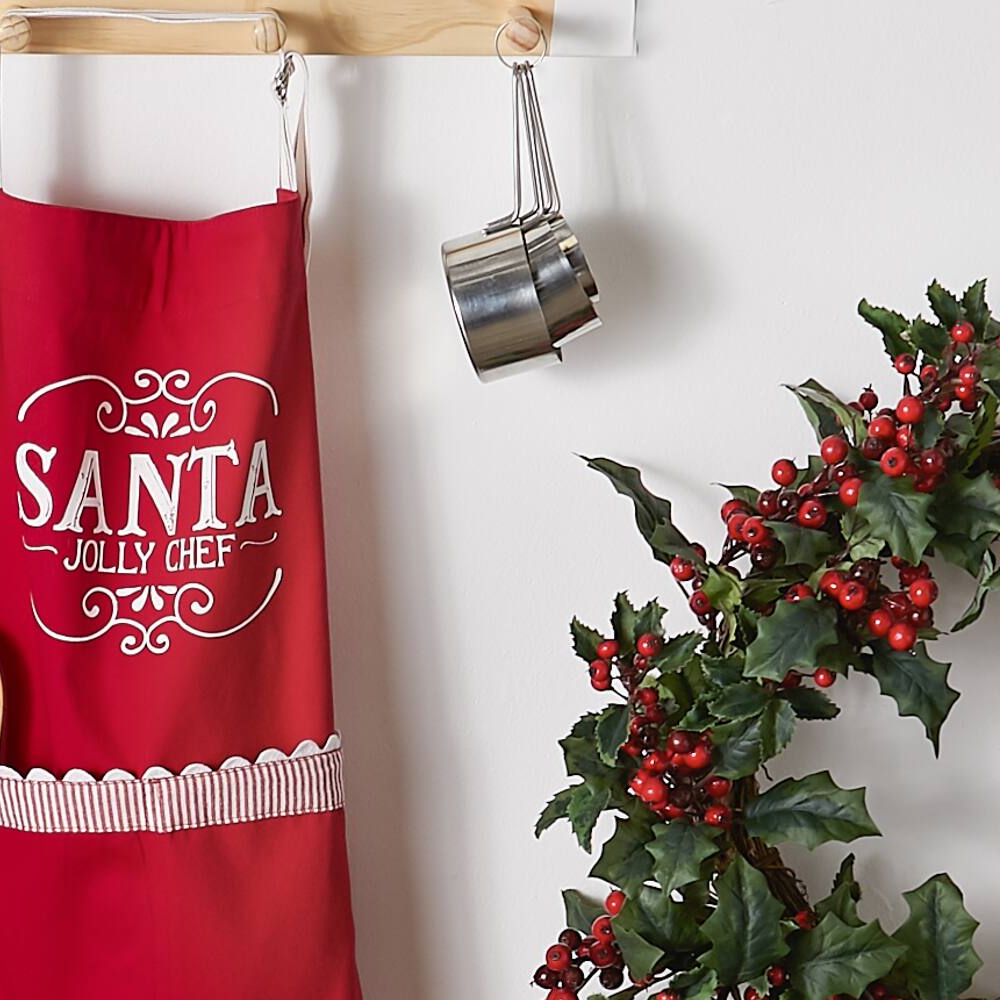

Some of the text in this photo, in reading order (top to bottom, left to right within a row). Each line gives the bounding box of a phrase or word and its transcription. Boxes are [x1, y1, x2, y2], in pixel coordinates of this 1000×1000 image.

[15, 439, 283, 537] SANTA
[63, 534, 236, 574] JOLLY CHEF
